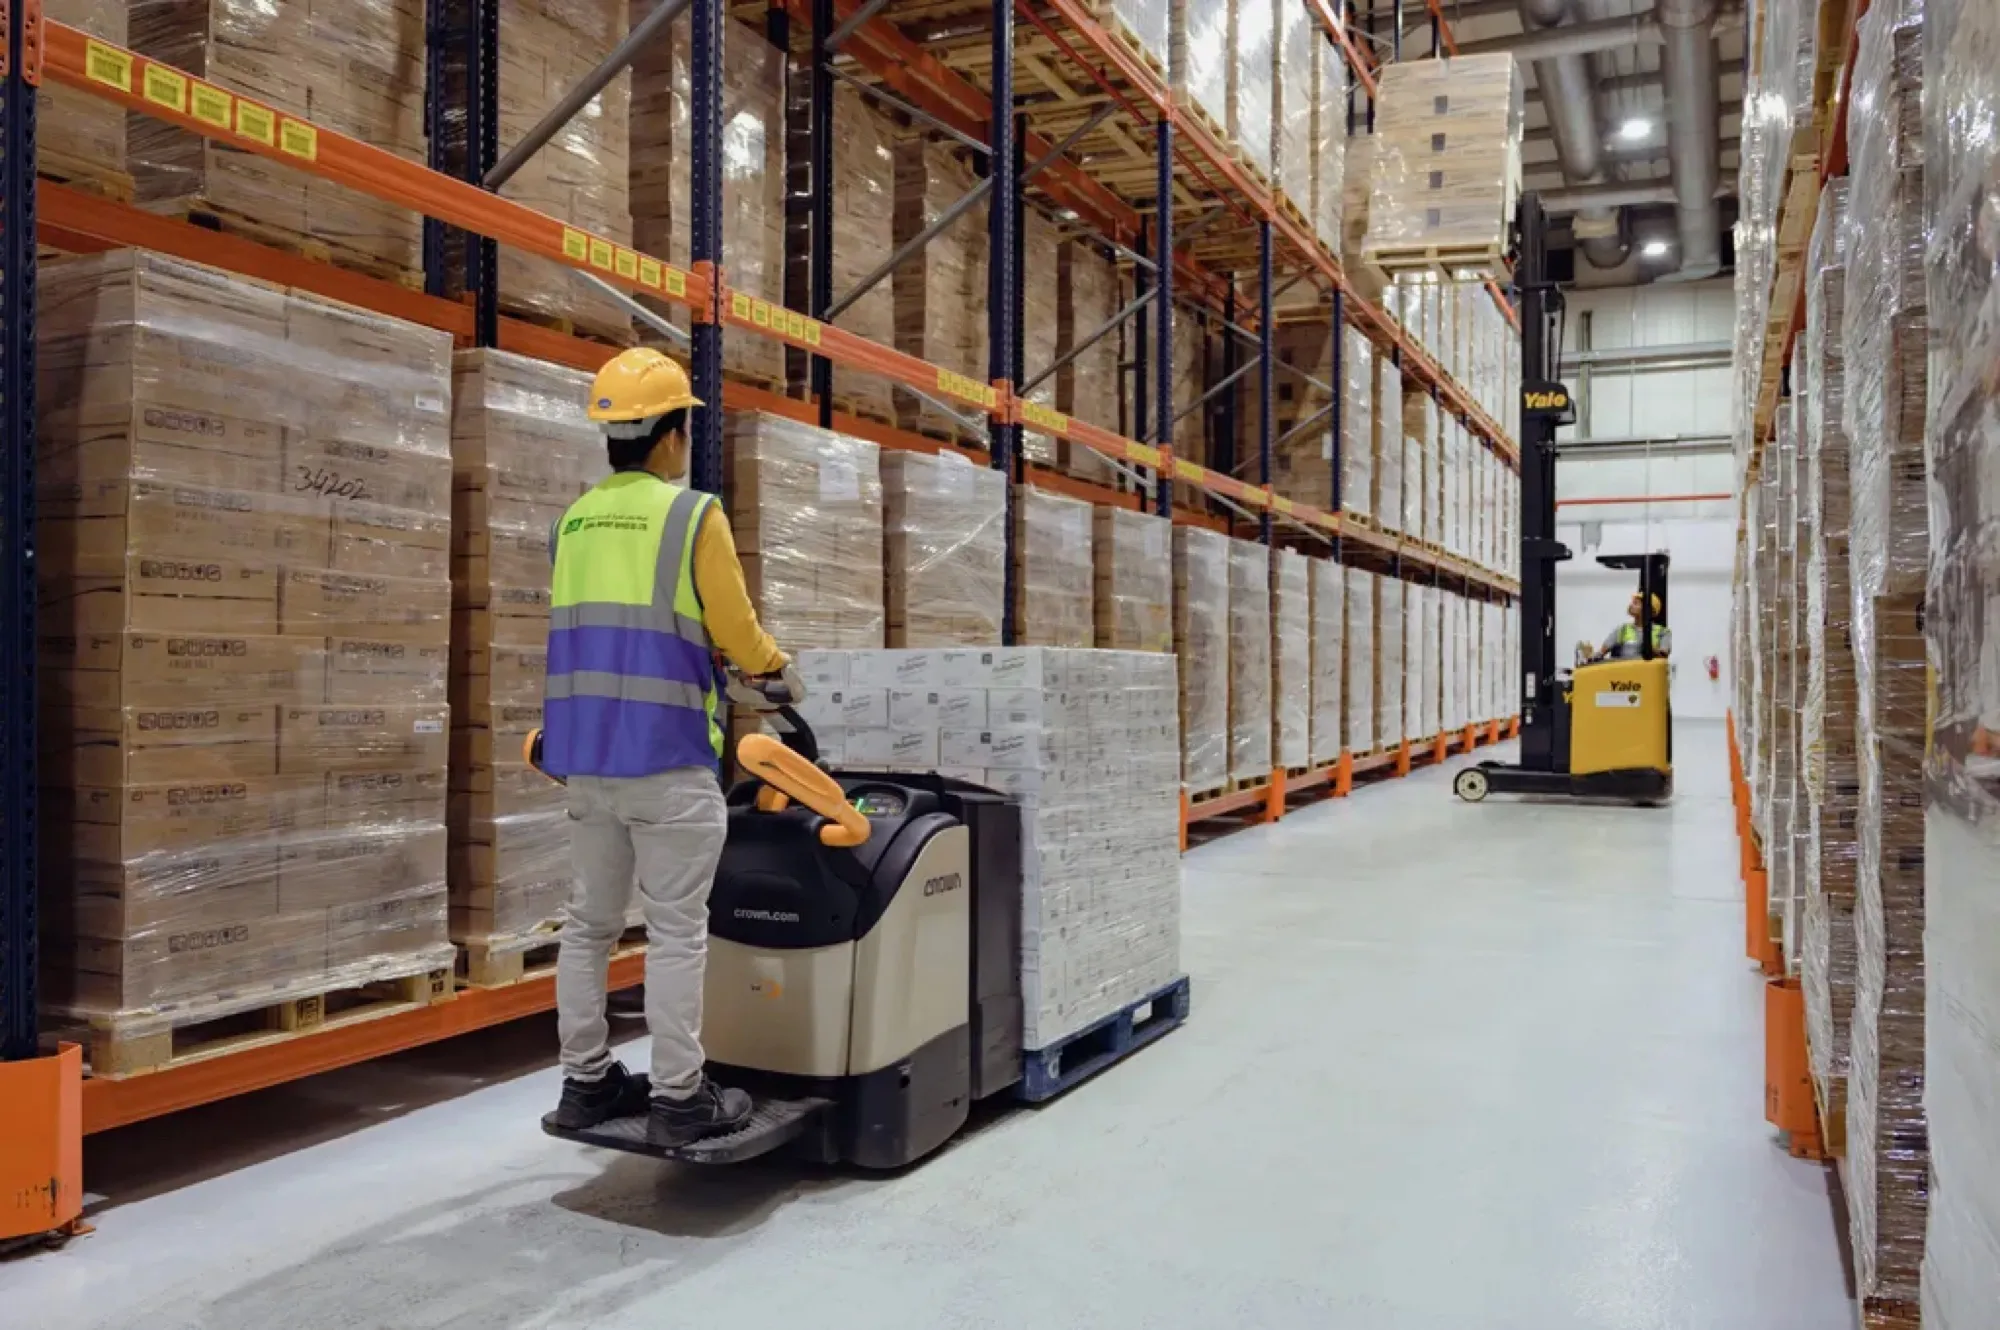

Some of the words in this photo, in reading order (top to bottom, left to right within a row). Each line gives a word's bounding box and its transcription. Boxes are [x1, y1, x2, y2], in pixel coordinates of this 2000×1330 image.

[1524, 391, 1567, 409] Yale
[295, 465, 372, 501] 34202
[1610, 680, 1642, 692] Yale
[733, 908, 800, 923] crown.com
